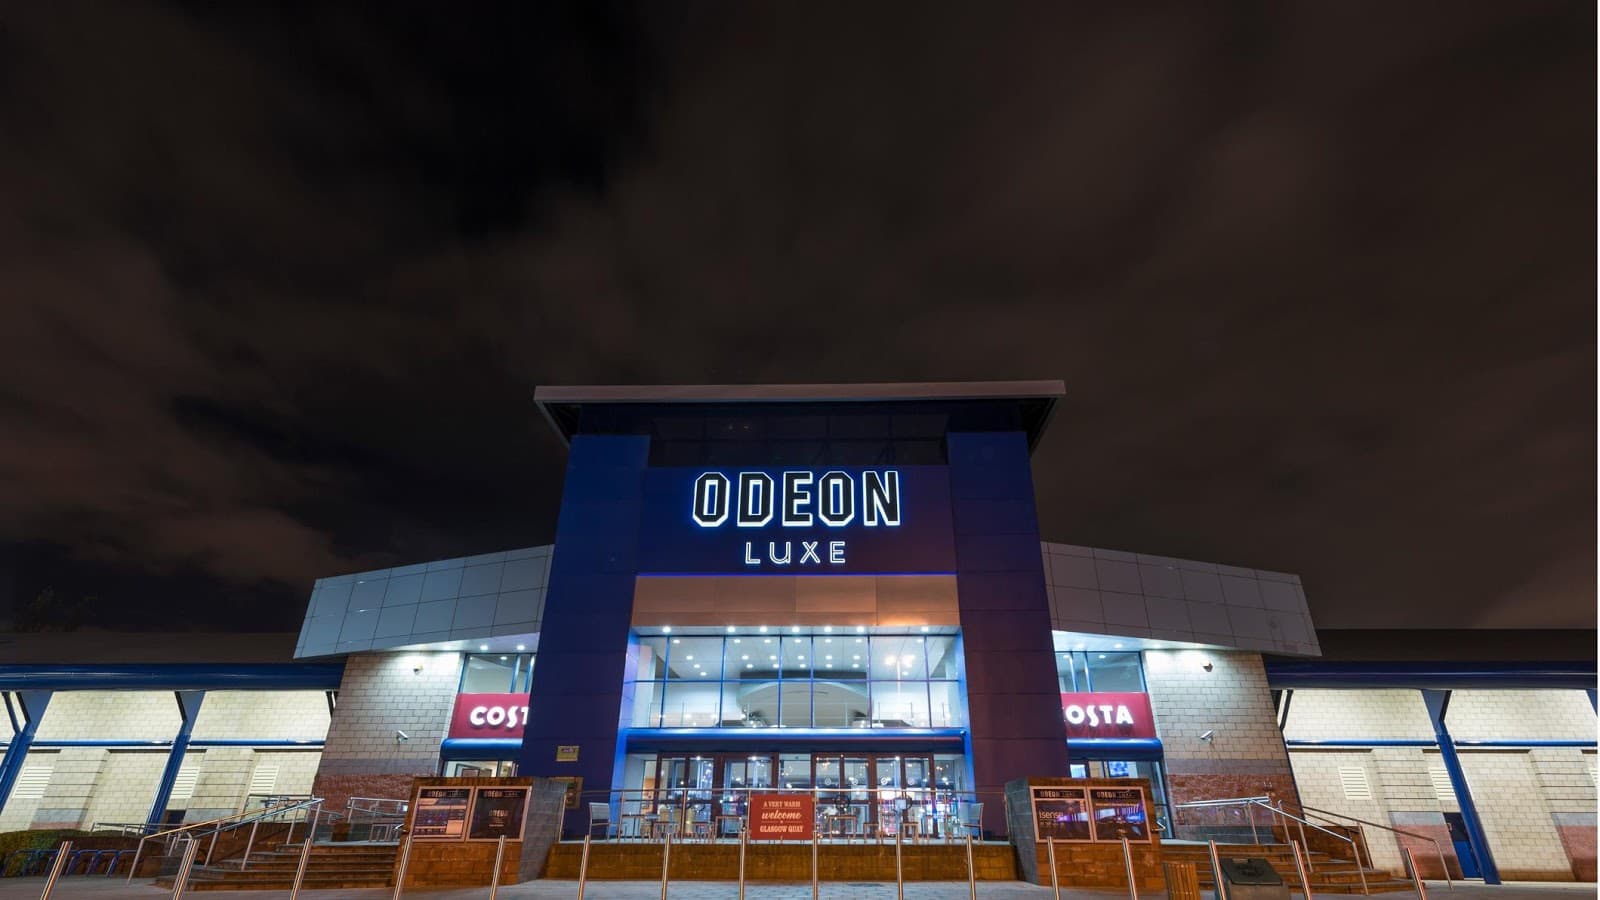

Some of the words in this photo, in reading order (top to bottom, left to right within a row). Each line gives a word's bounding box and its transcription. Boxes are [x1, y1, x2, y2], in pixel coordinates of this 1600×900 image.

[692, 471, 901, 527] ODEON
[745, 541, 846, 564] LUXE
[1063, 705, 1134, 727] OSTA
[761, 810, 802, 820] welcome
